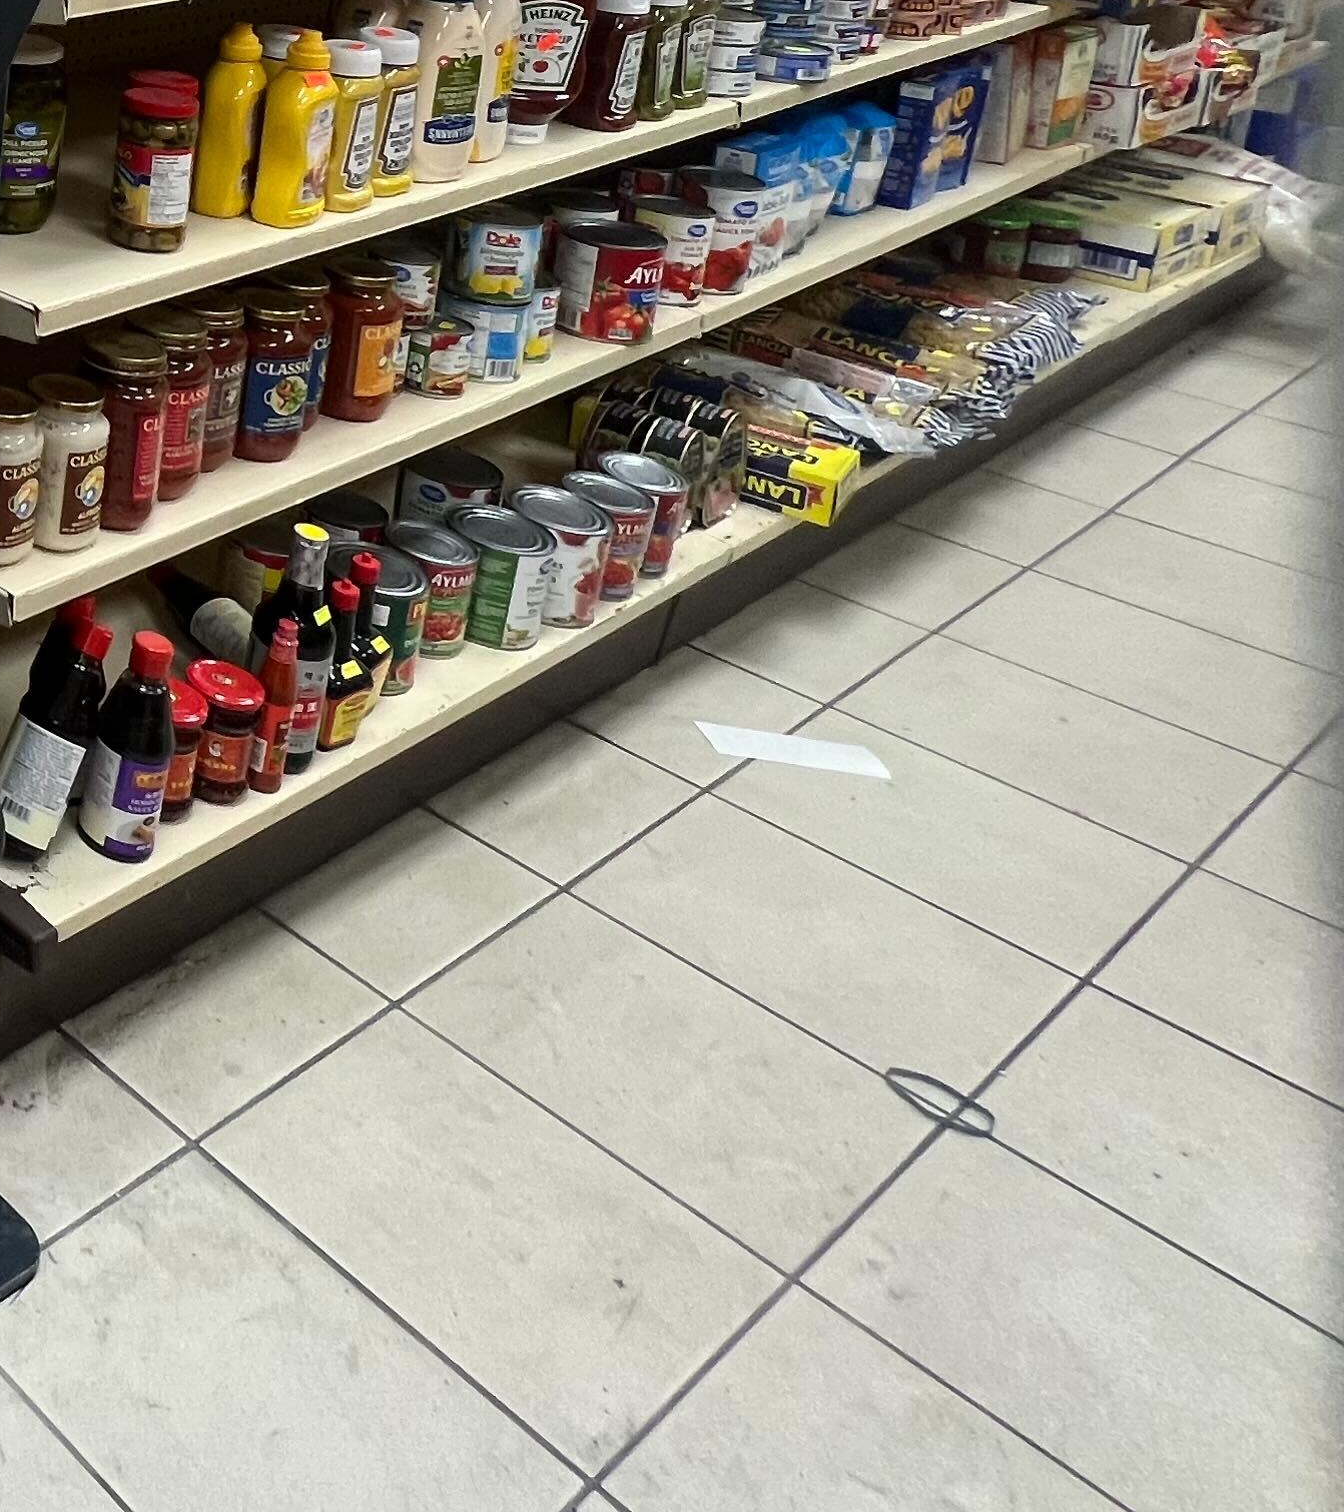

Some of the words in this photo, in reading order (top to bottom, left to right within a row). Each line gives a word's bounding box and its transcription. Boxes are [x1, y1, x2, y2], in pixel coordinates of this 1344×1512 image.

[529, 8, 572, 21] HEINZ
[486, 231, 522, 248] Dole
[624, 266, 664, 284] AYL
[747, 474, 801, 505] LAN
